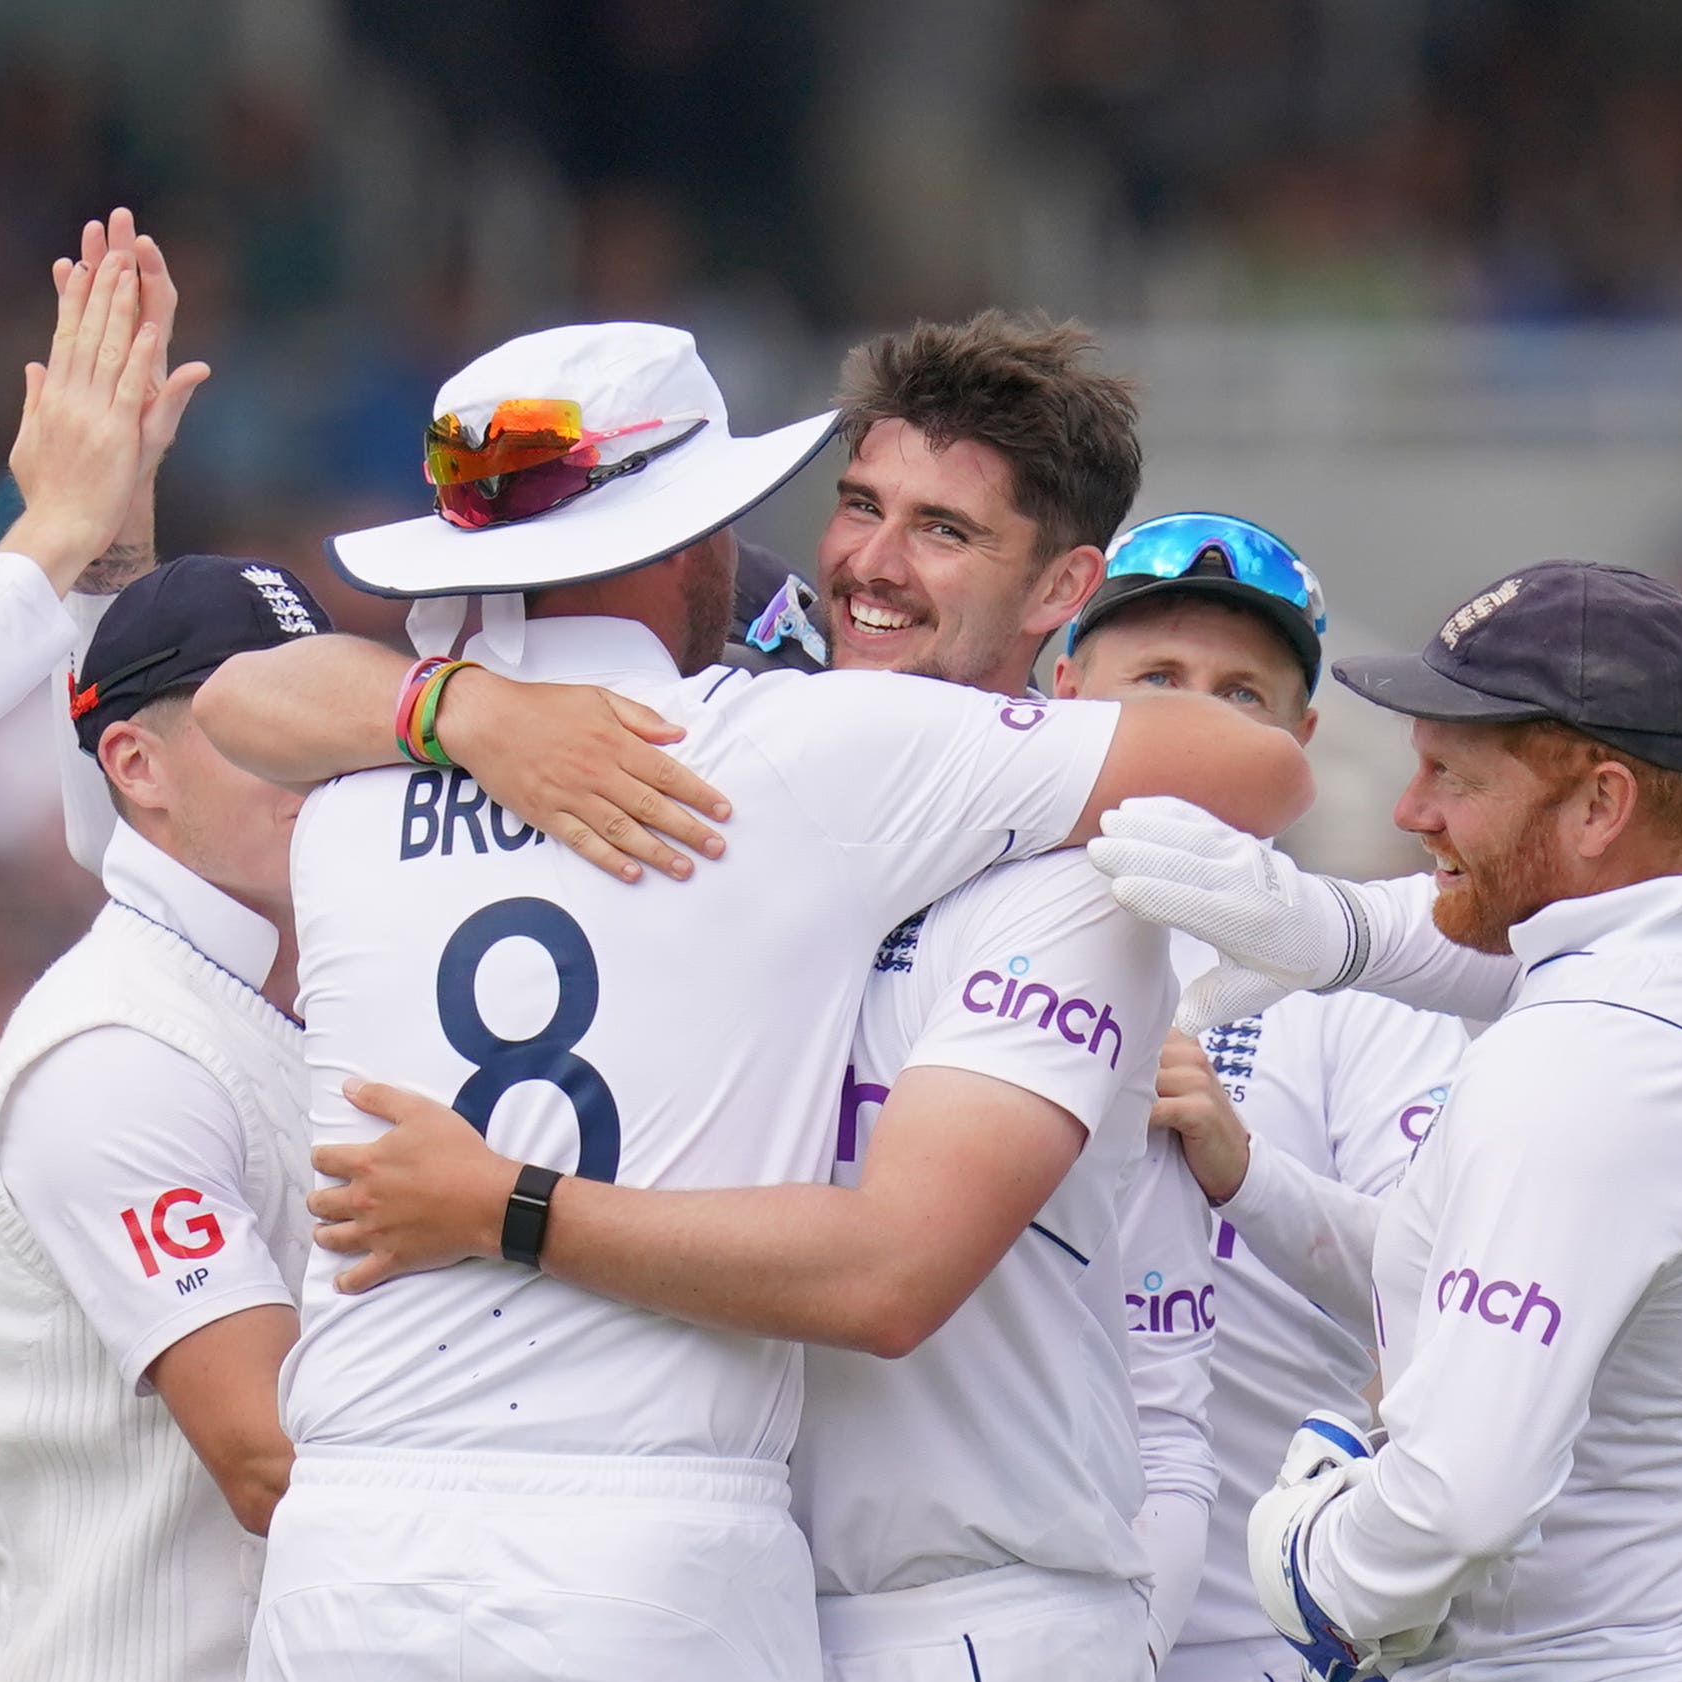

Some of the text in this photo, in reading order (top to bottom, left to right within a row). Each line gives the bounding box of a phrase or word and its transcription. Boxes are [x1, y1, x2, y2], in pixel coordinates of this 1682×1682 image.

[400, 764, 546, 861] BRO
[437, 897, 621, 1186] 8
[962, 955, 1122, 1071] cinch
[120, 1187, 226, 1278] IG
[175, 1268, 210, 1296] MP
